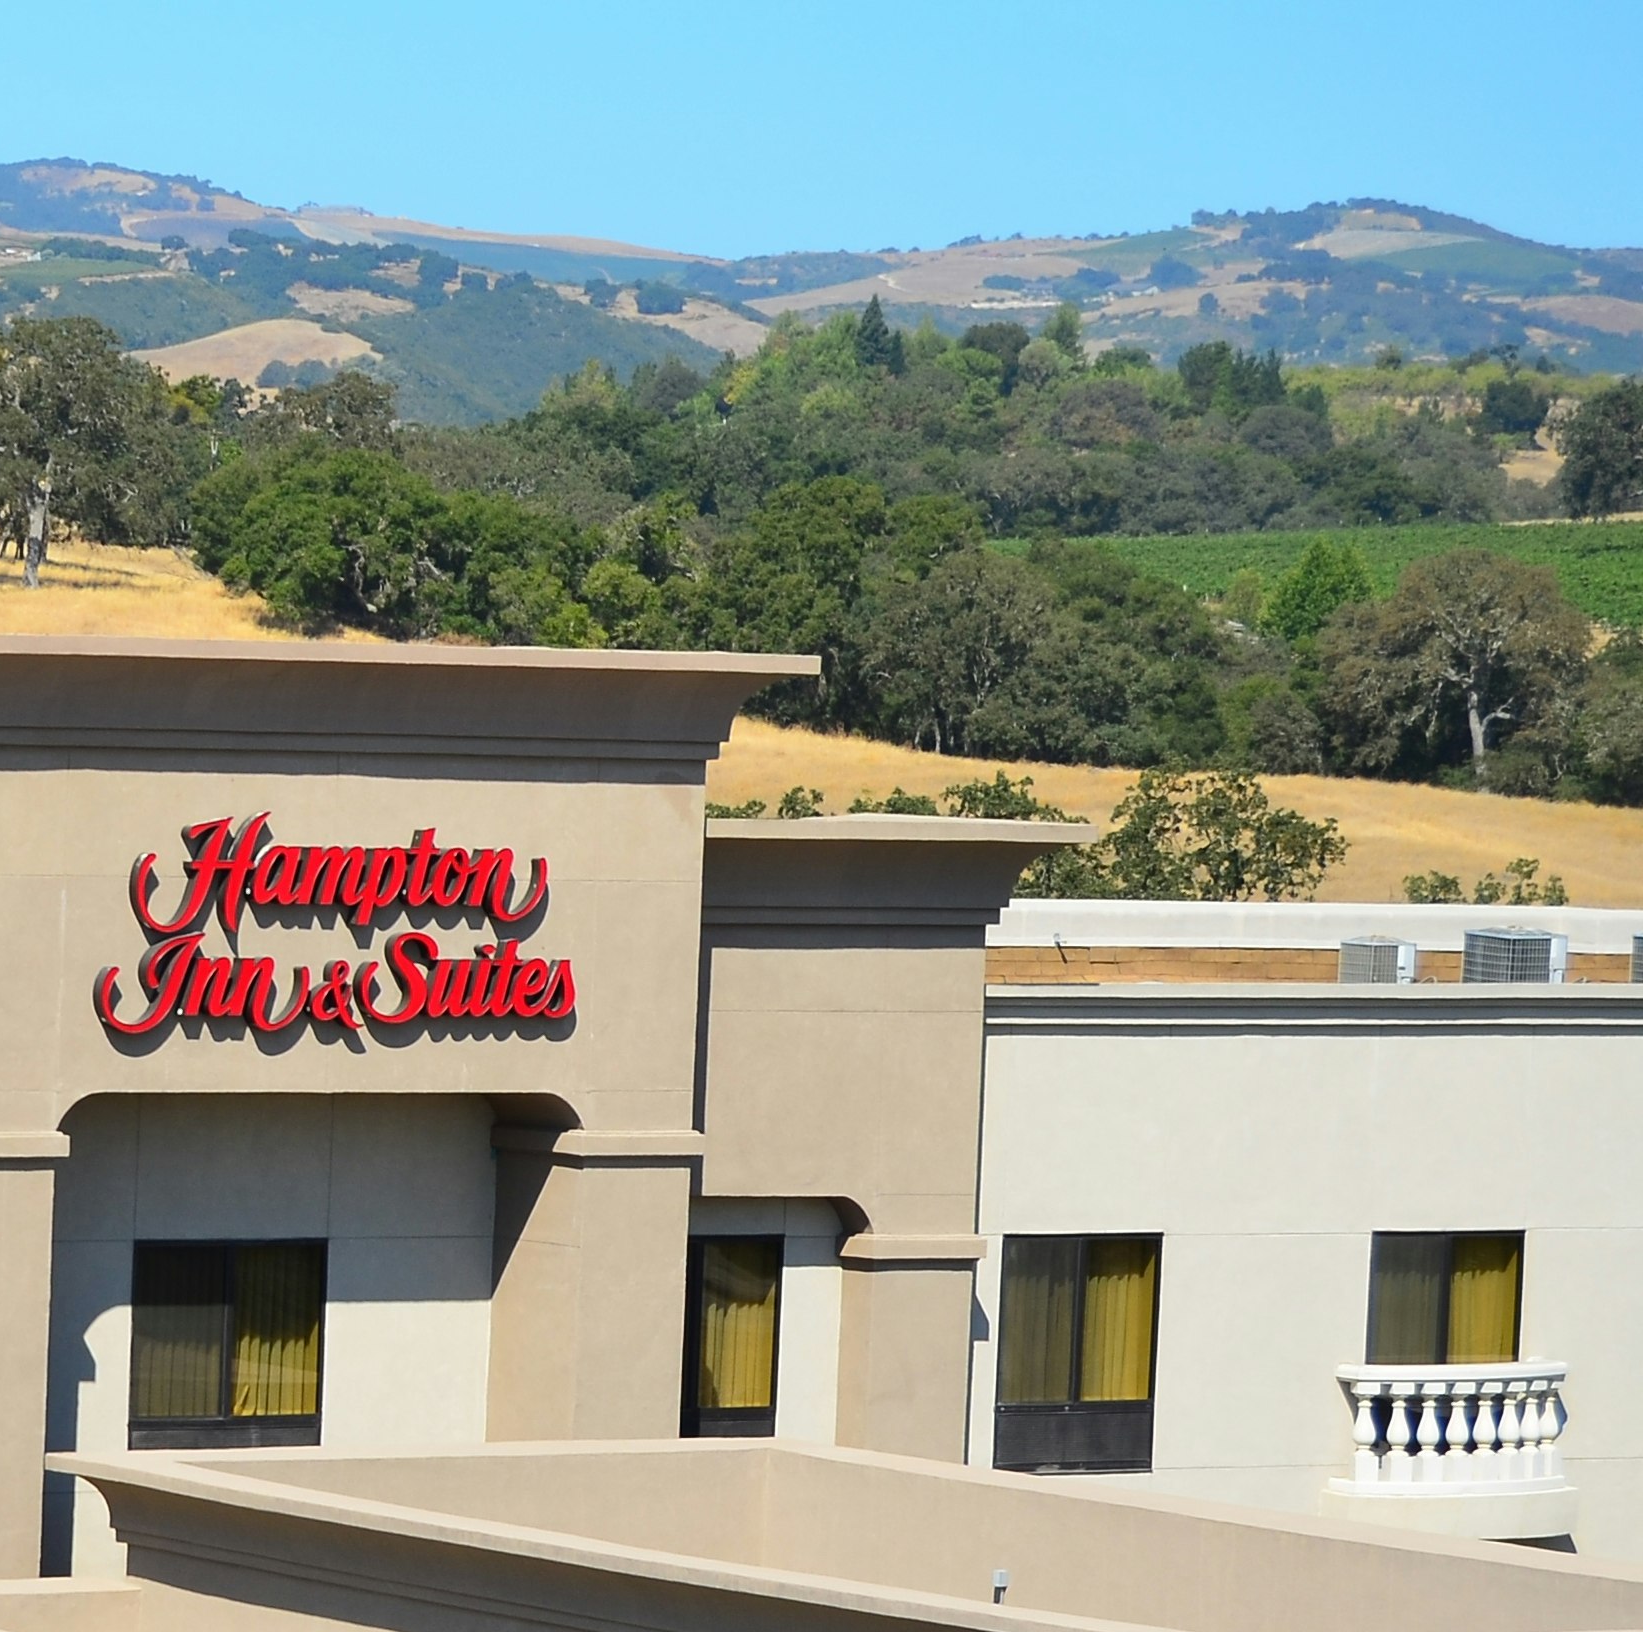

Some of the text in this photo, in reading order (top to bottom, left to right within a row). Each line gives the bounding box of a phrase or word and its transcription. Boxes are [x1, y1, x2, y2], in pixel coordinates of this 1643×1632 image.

[129, 811, 549, 933] Hampton
[94, 932, 576, 1034] Inn & Suites
